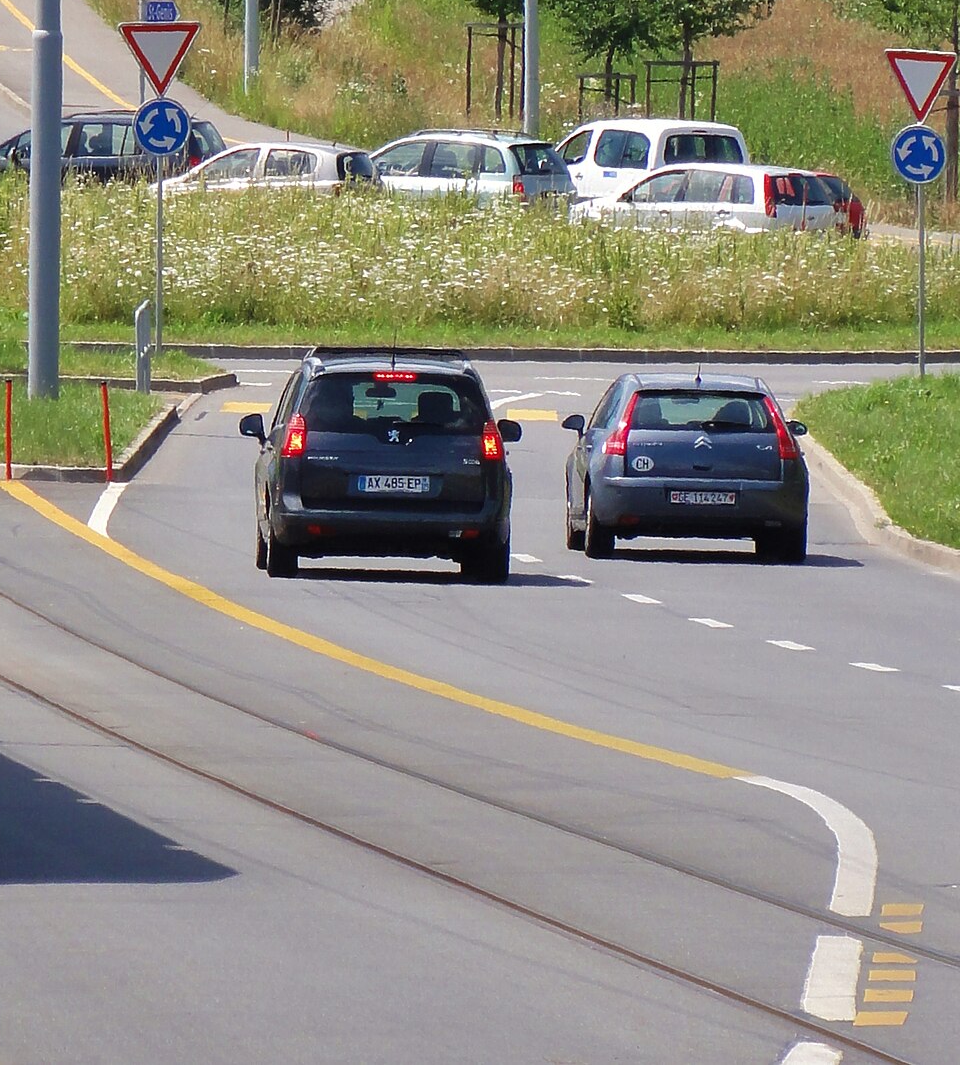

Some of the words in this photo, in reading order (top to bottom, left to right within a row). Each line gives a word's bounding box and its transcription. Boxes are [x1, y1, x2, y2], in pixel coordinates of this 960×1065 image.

[636, 458, 649, 470] CH
[367, 477, 381, 489] AX
[384, 477, 405, 489] 485
[407, 478, 421, 490] EP
